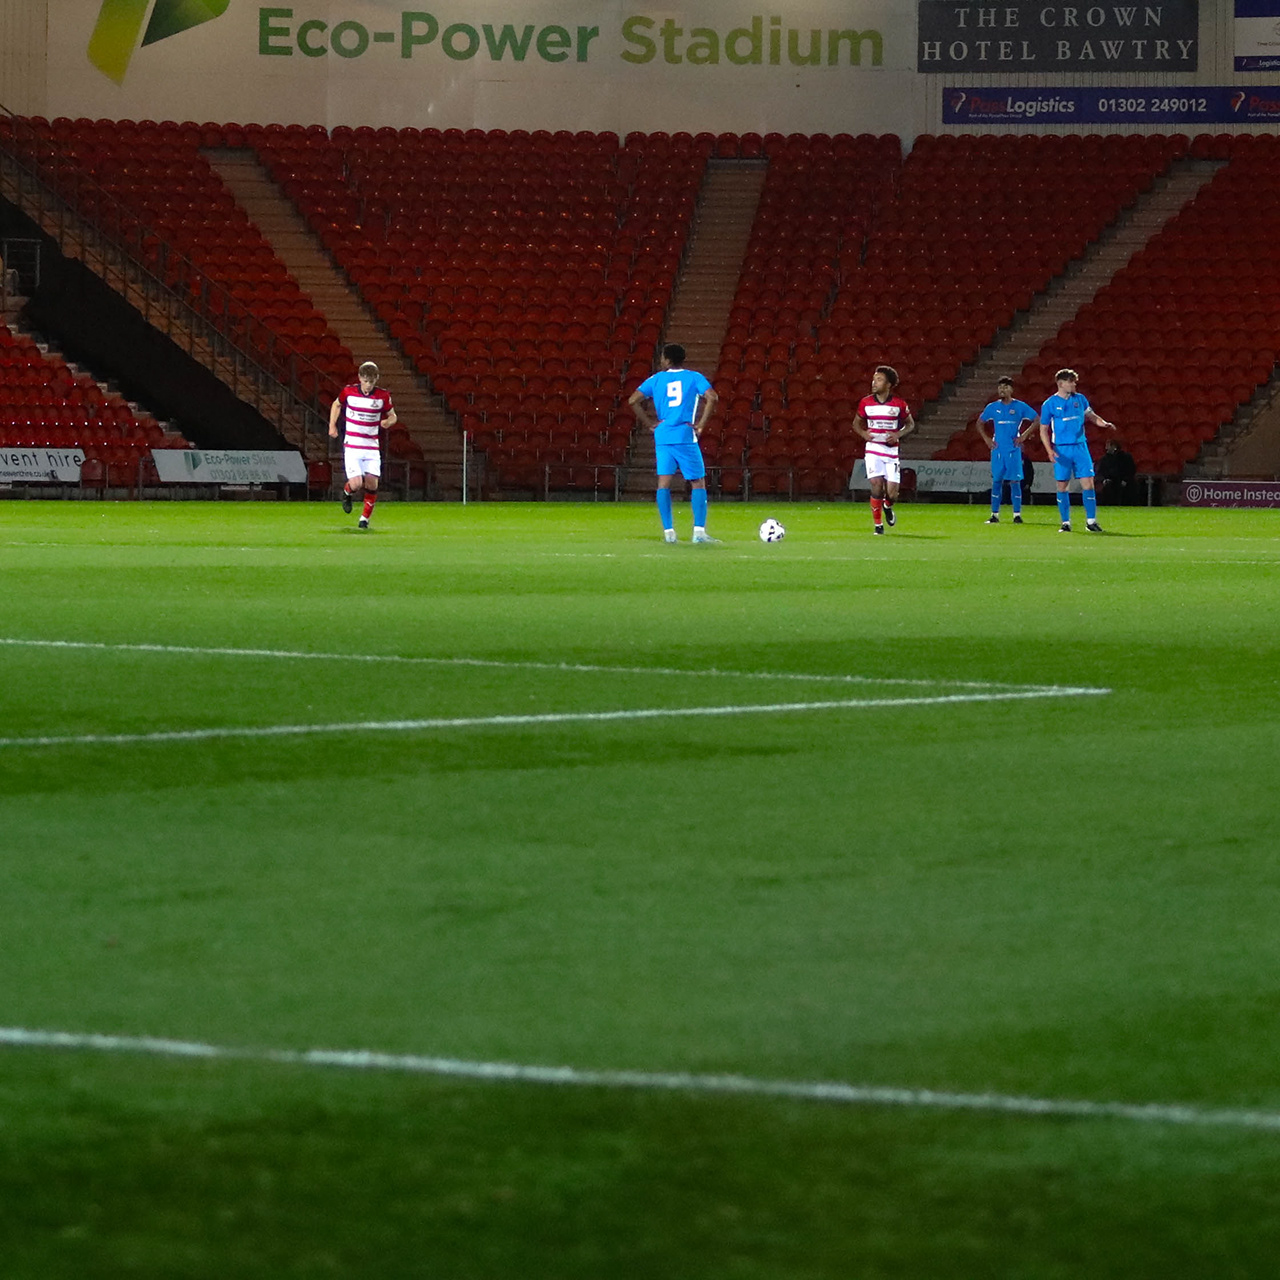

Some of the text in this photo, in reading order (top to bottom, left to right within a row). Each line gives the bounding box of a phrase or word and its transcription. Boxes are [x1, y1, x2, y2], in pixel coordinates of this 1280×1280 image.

[954, 6, 1164, 28] THE CROWN
[258, 6, 885, 68] Eco-Power Stadium
[921, 39, 1195, 61] HOTEL BAWTRY
[970, 95, 1208, 117] PassLogistics 01302 249012
[667, 380, 683, 408] 9
[46, 451, 82, 468] hire
[204, 453, 251, 466] Eco-Power
[1204, 487, 1242, 501] Home
